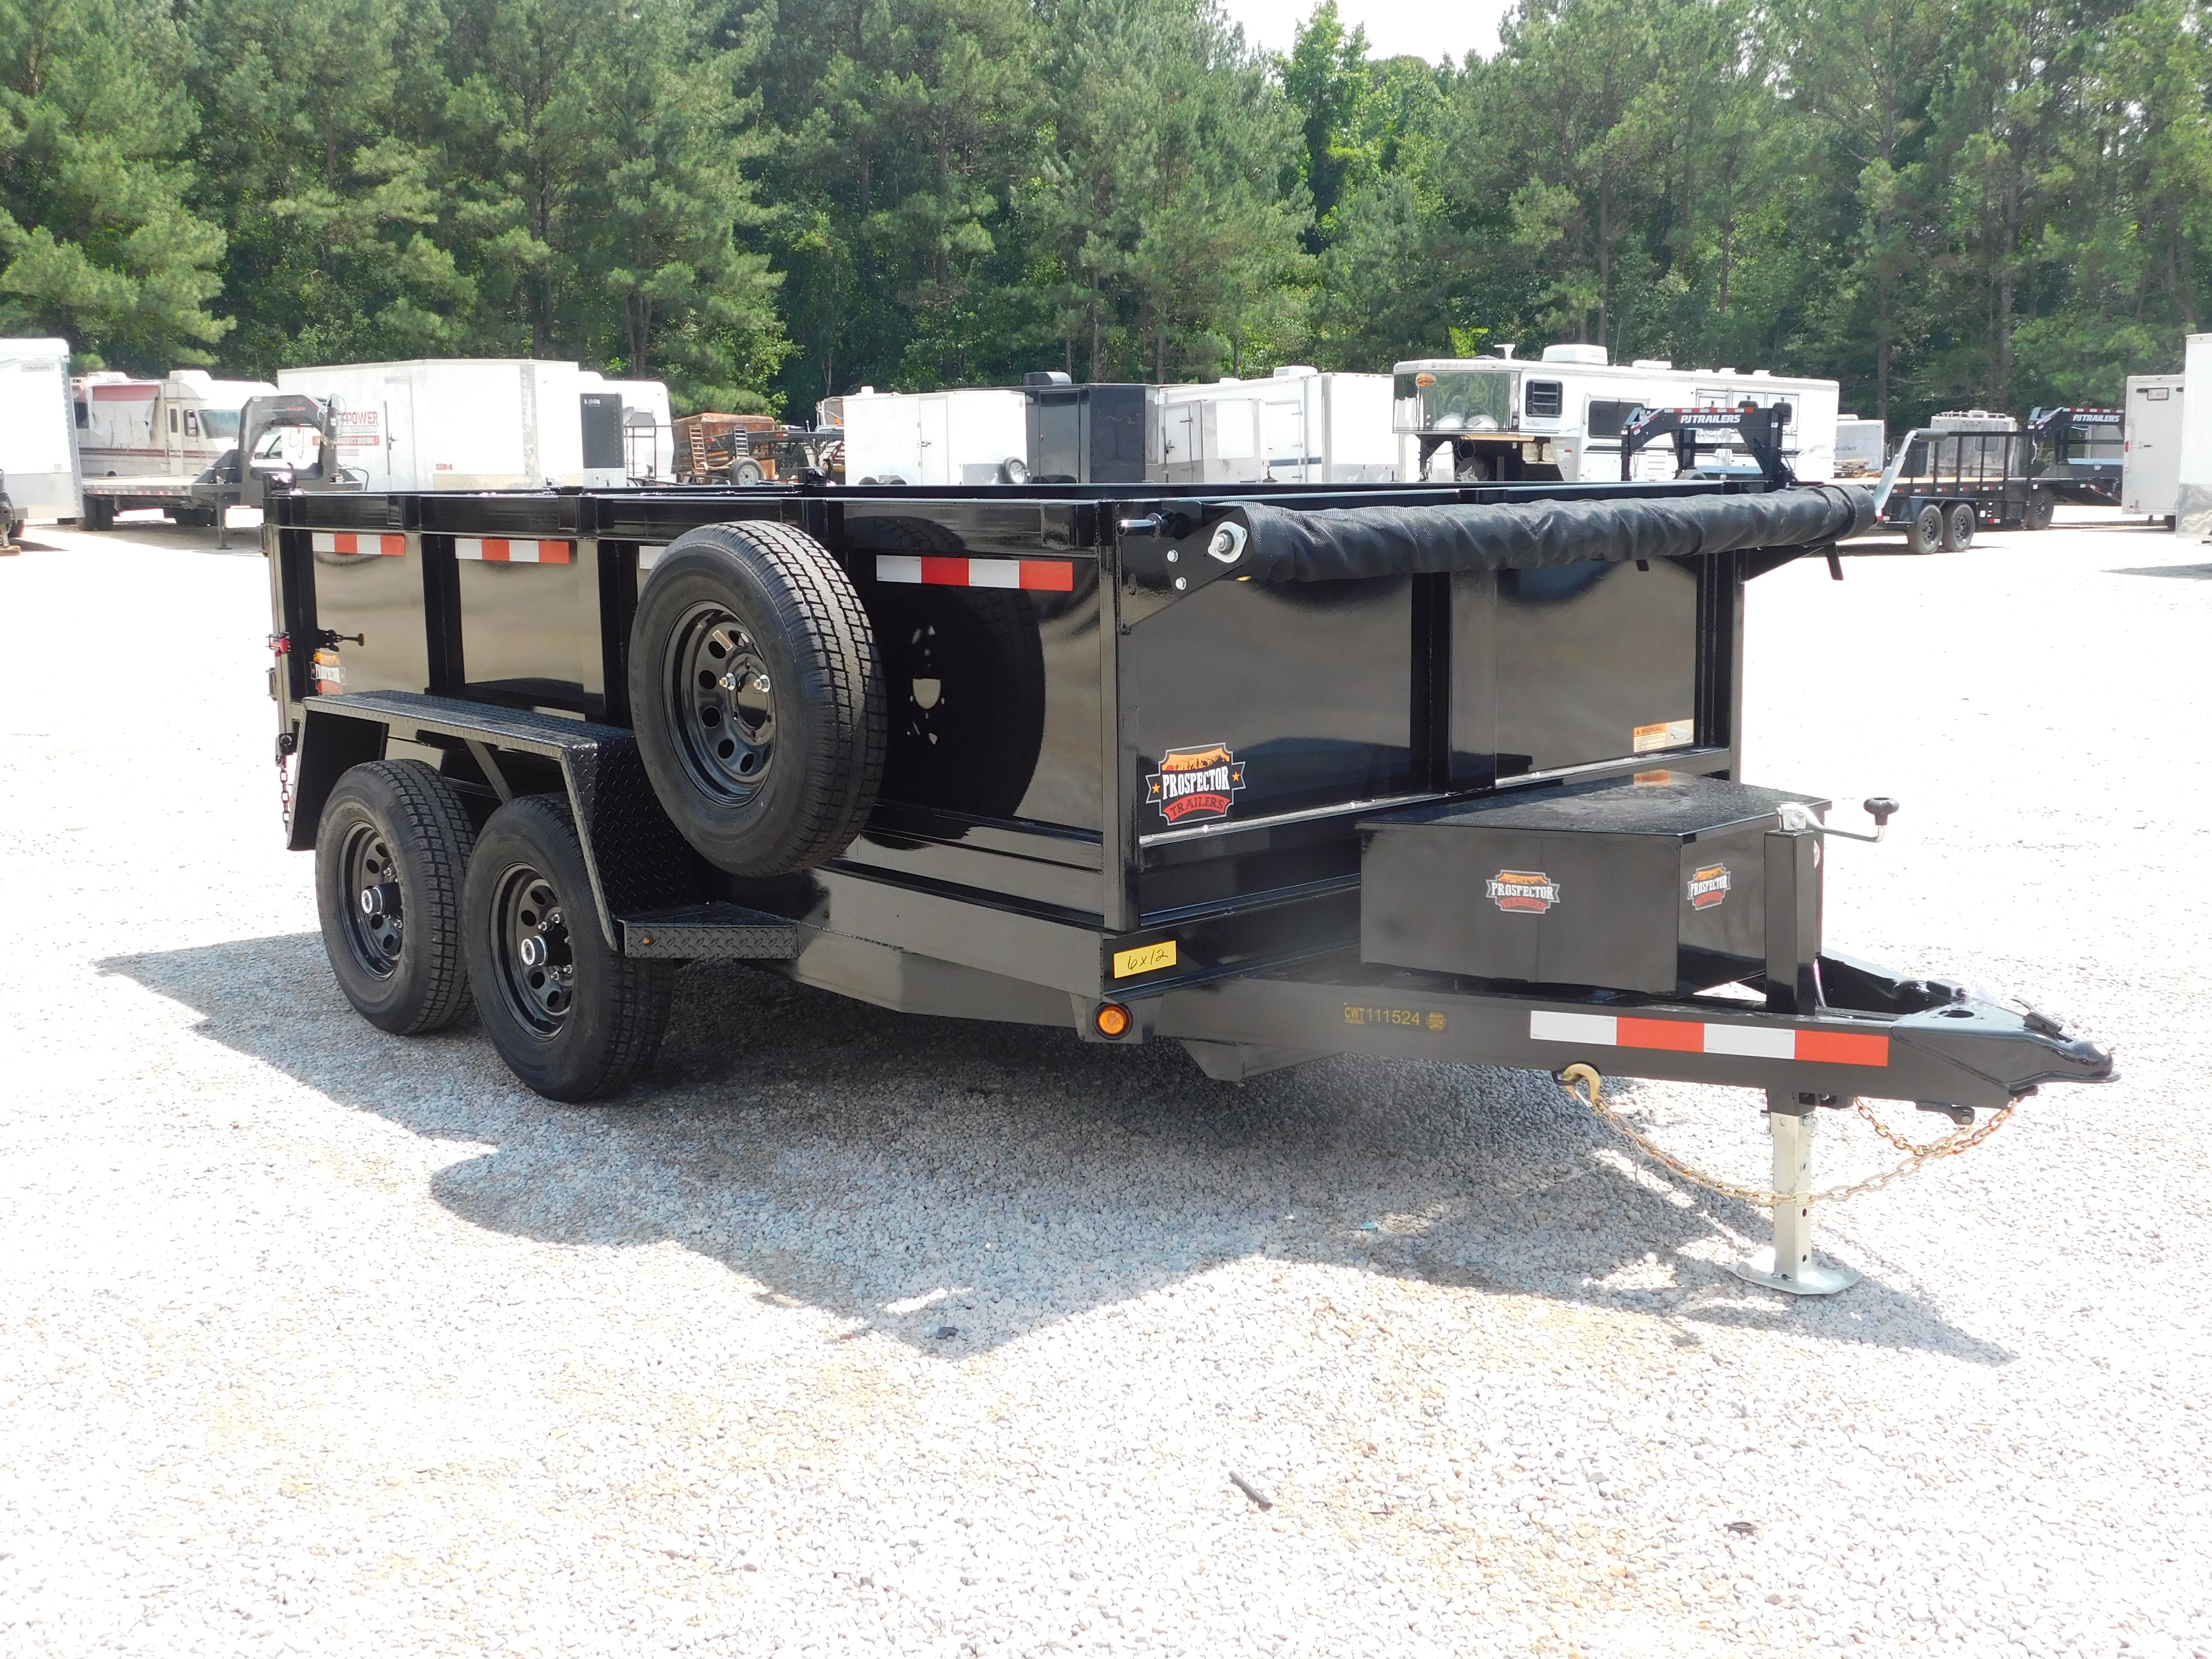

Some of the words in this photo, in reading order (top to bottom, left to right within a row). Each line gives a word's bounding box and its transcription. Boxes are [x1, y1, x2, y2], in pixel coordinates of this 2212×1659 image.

[1641, 725, 1662, 734] WARNING
[1162, 766, 1230, 800] PROSPECTOR
[1170, 796, 1224, 817] TRAILERS
[1491, 882, 1555, 900] PROSPECTOR
[1690, 875, 1728, 898] PROSPECTOR
[1127, 949, 1168, 971] 6x12
[1345, 1007, 1365, 1020] CWT
[1366, 1008, 1421, 1026] 111524
